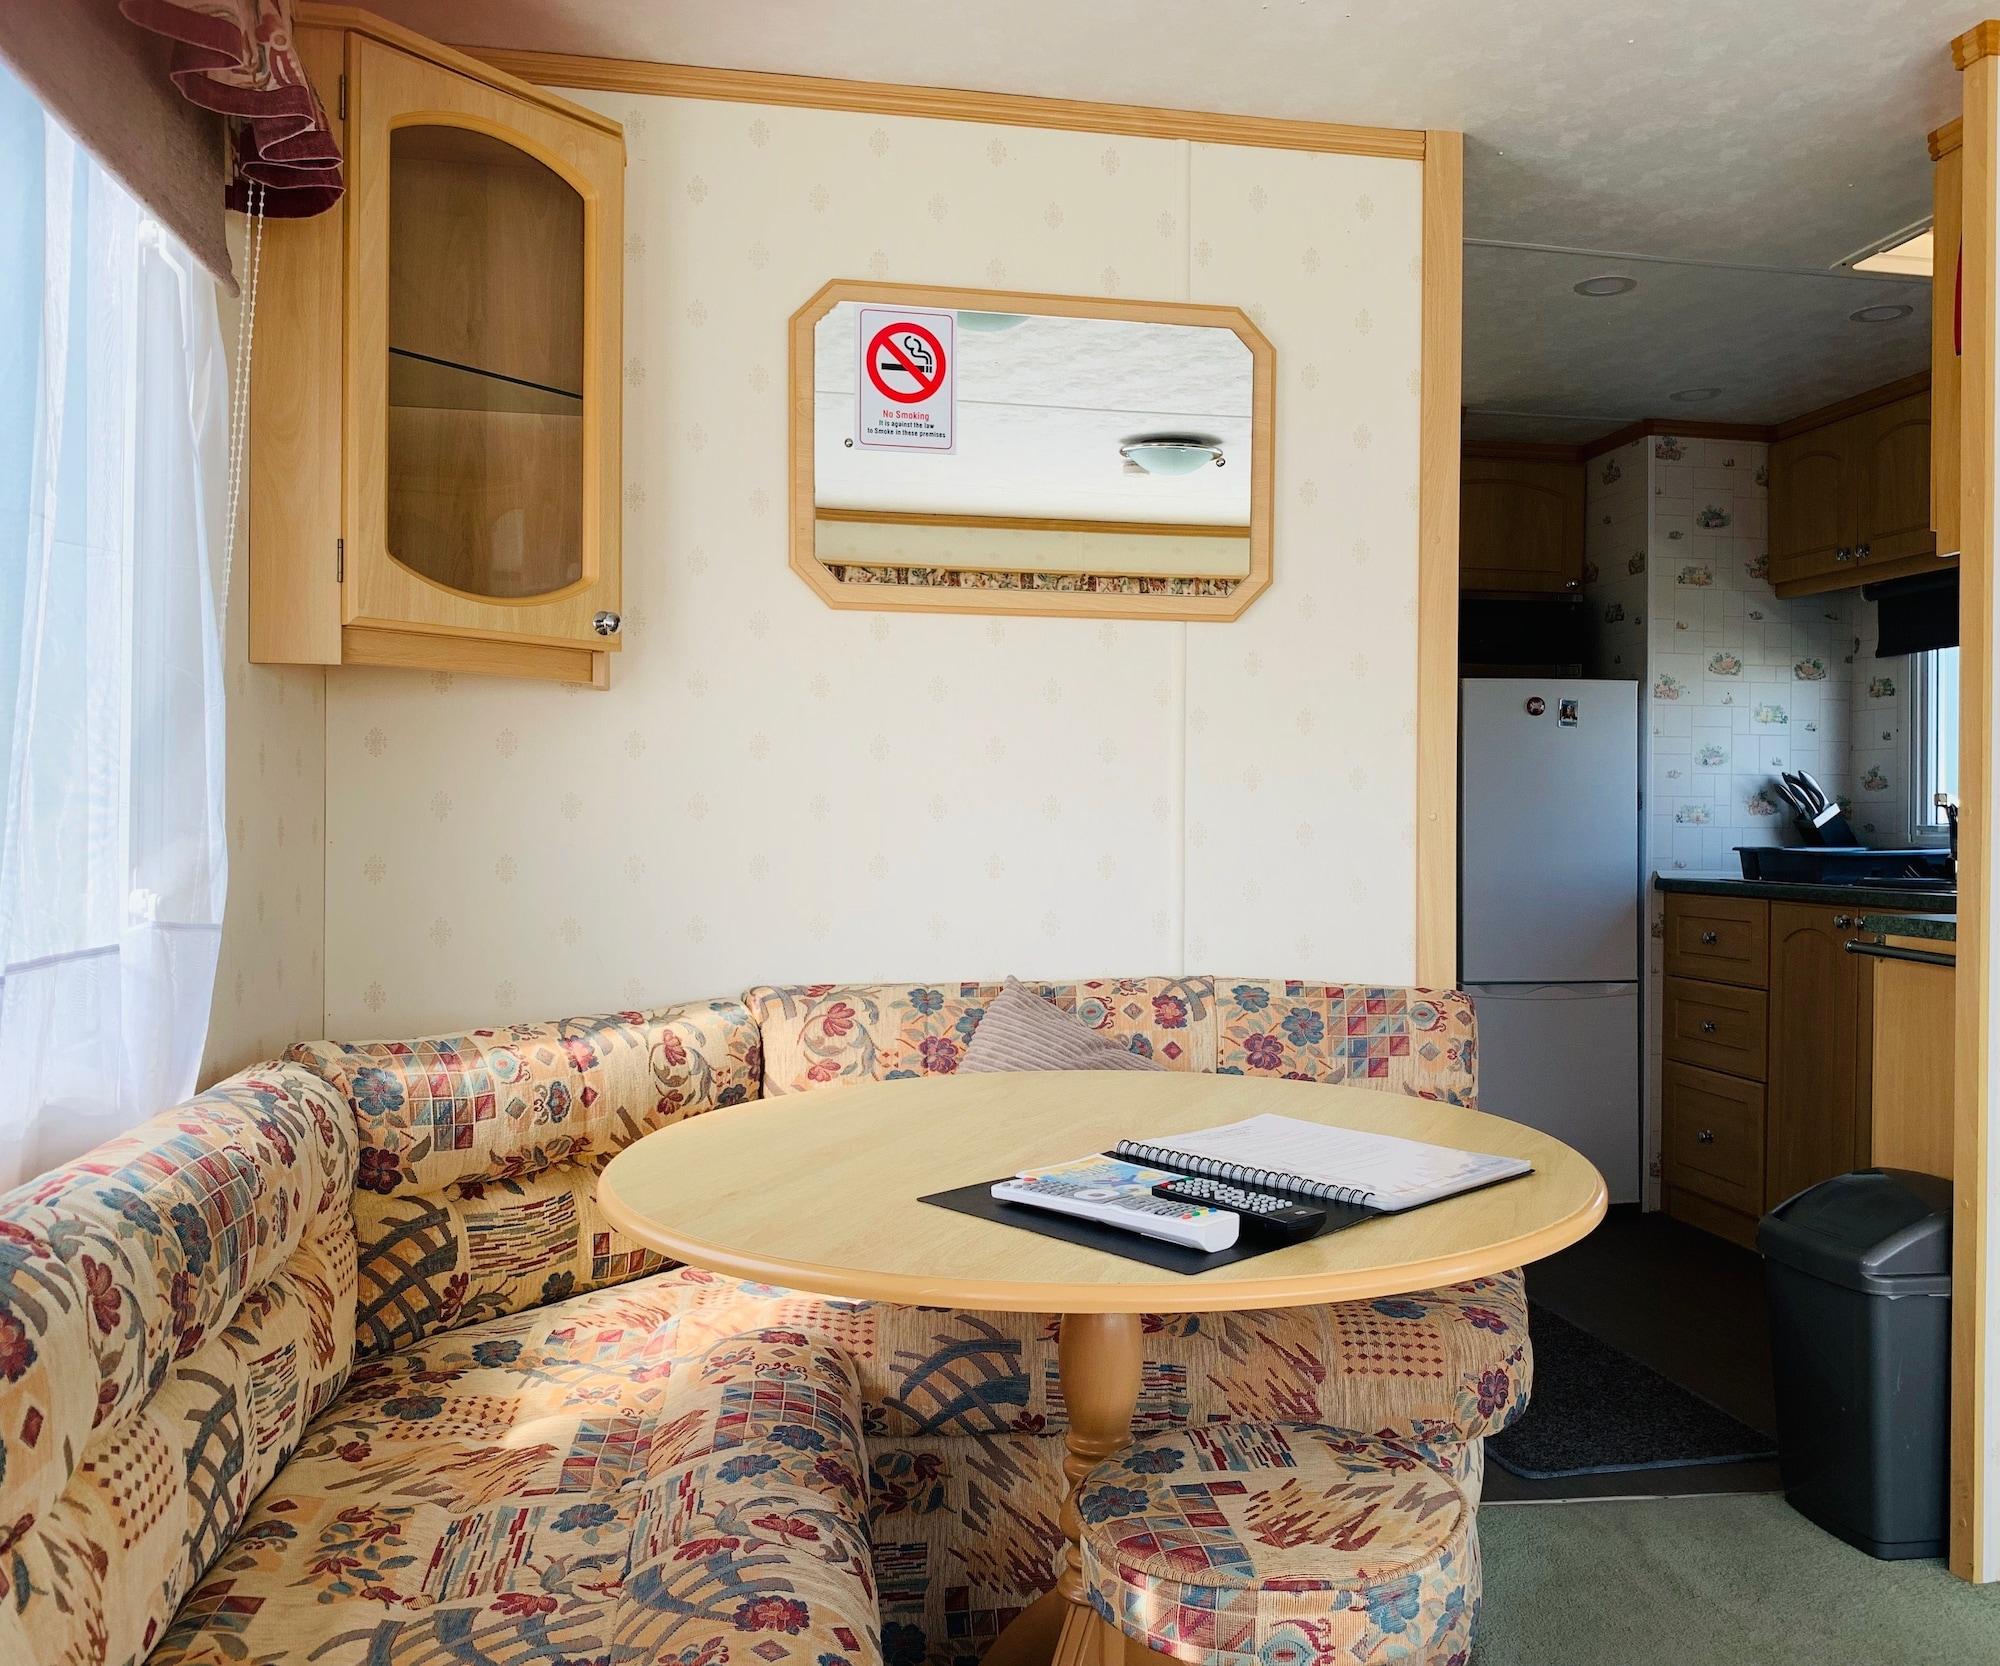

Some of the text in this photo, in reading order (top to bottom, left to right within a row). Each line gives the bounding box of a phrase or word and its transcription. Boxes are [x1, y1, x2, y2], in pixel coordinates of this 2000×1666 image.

[883, 410, 930, 421] No Smoking
[902, 429, 918, 437] these
